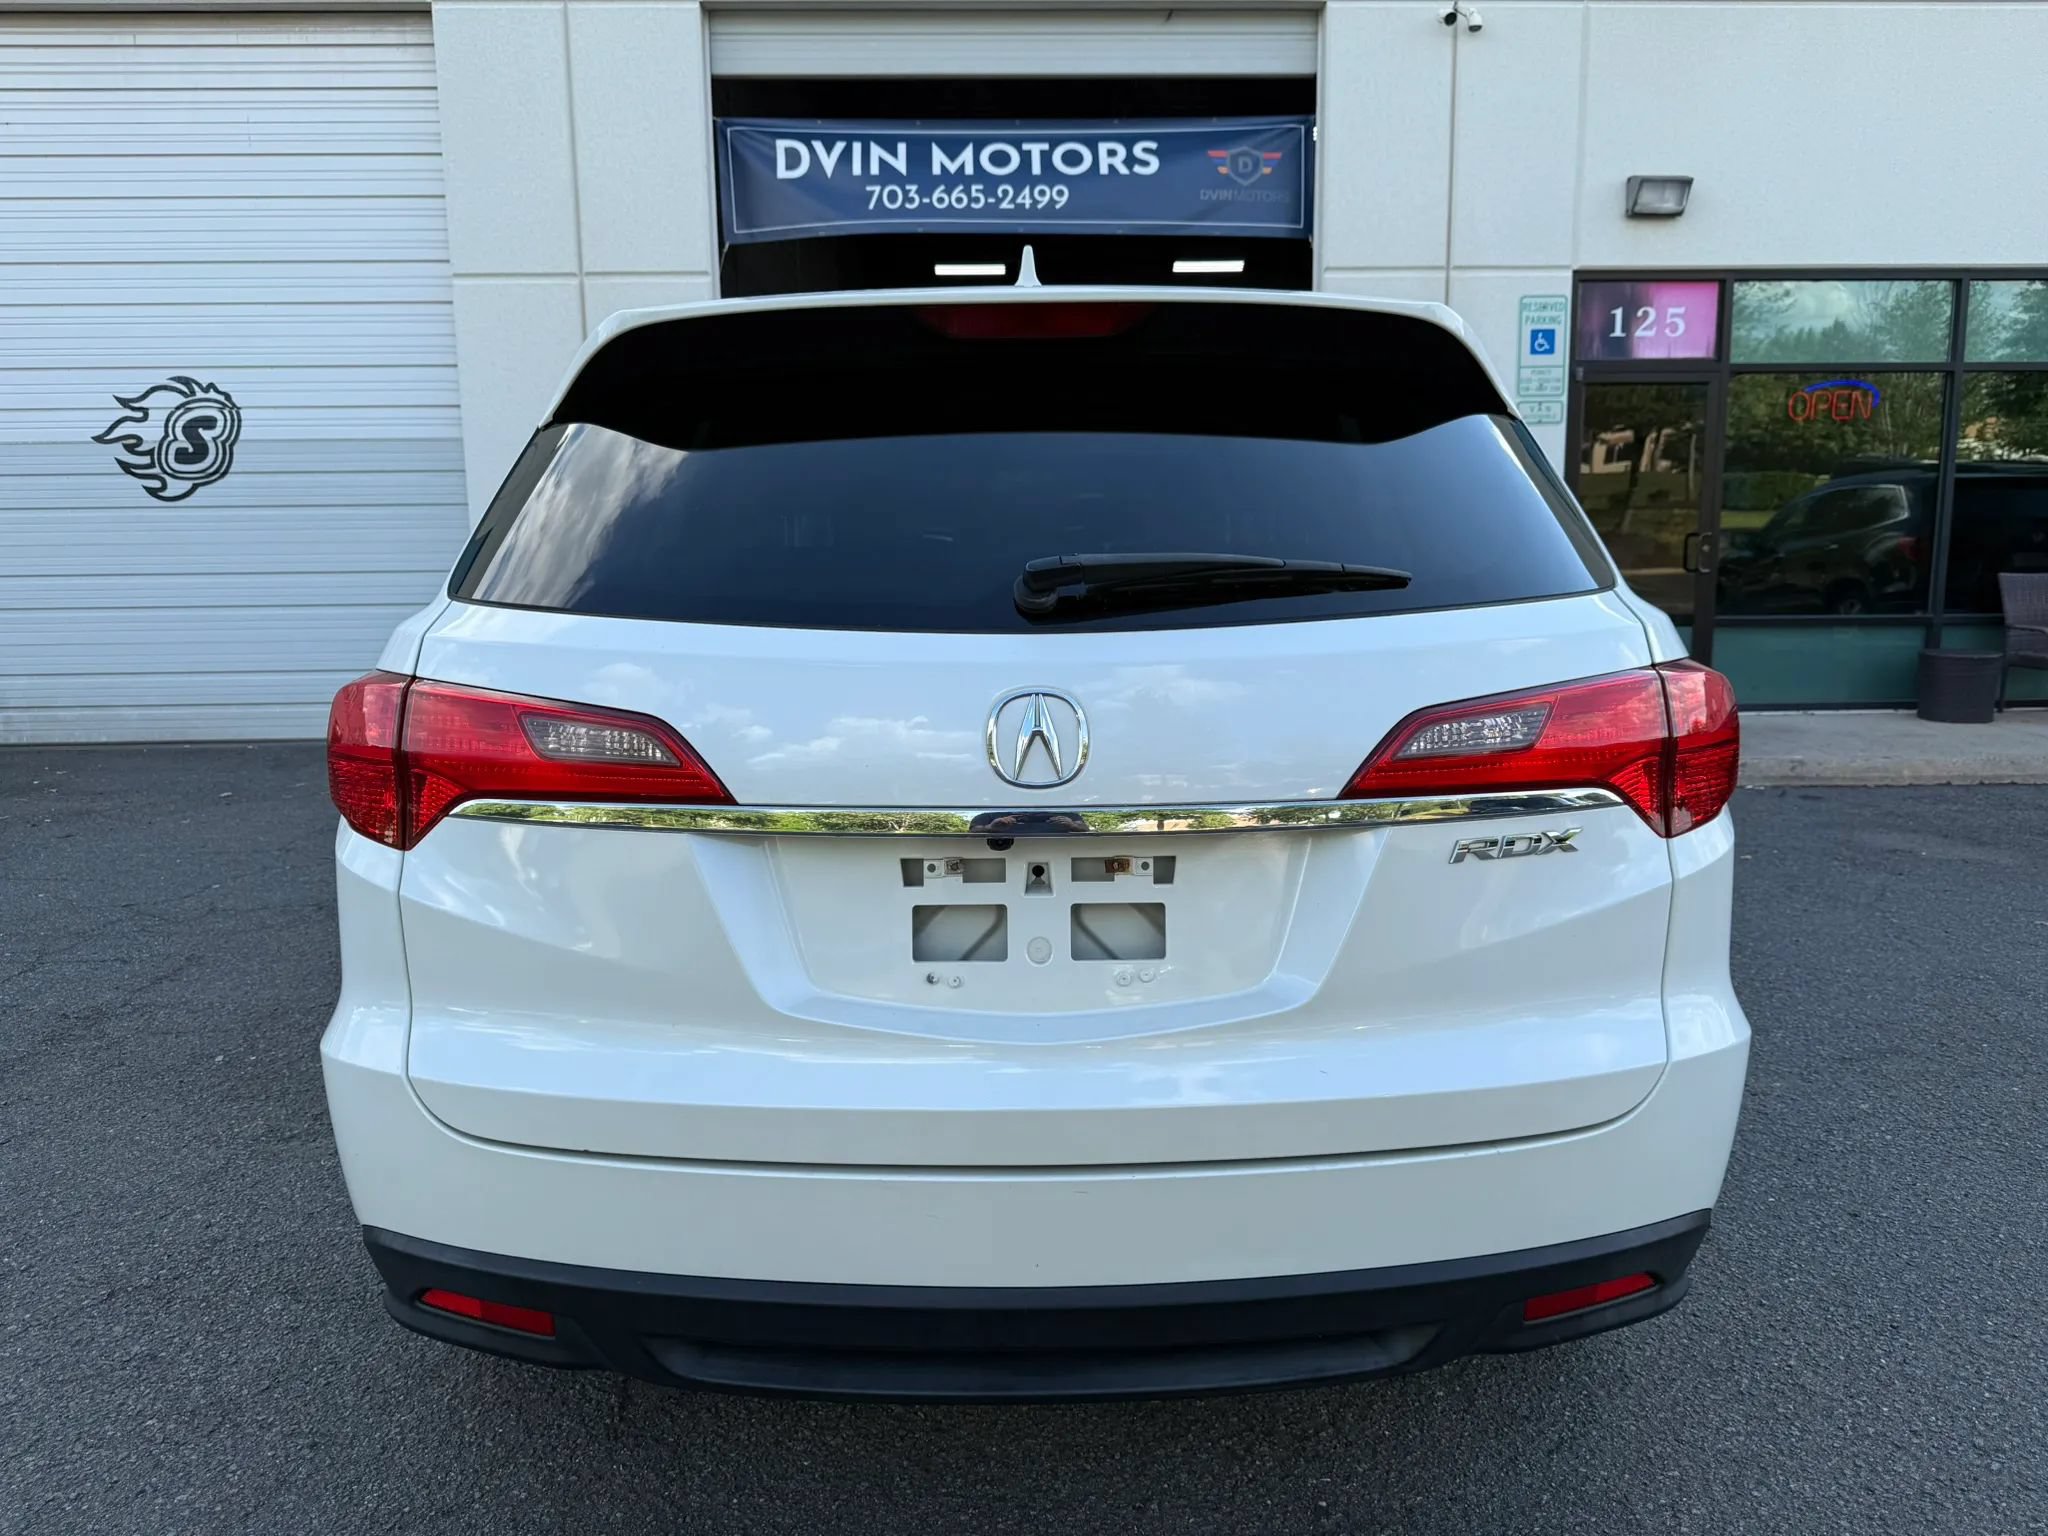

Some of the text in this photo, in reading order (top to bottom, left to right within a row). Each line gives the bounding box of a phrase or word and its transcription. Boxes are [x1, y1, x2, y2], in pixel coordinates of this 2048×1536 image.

[775, 139, 1160, 179] DVIN MOTORS
[1238, 156, 1253, 173] D
[865, 183, 1070, 210] 703-665-2499
[1524, 314, 1562, 326] PARKING
[1609, 306, 1687, 338] 125
[1788, 390, 1873, 421] OPEN
[1449, 826, 1584, 864] RDX
